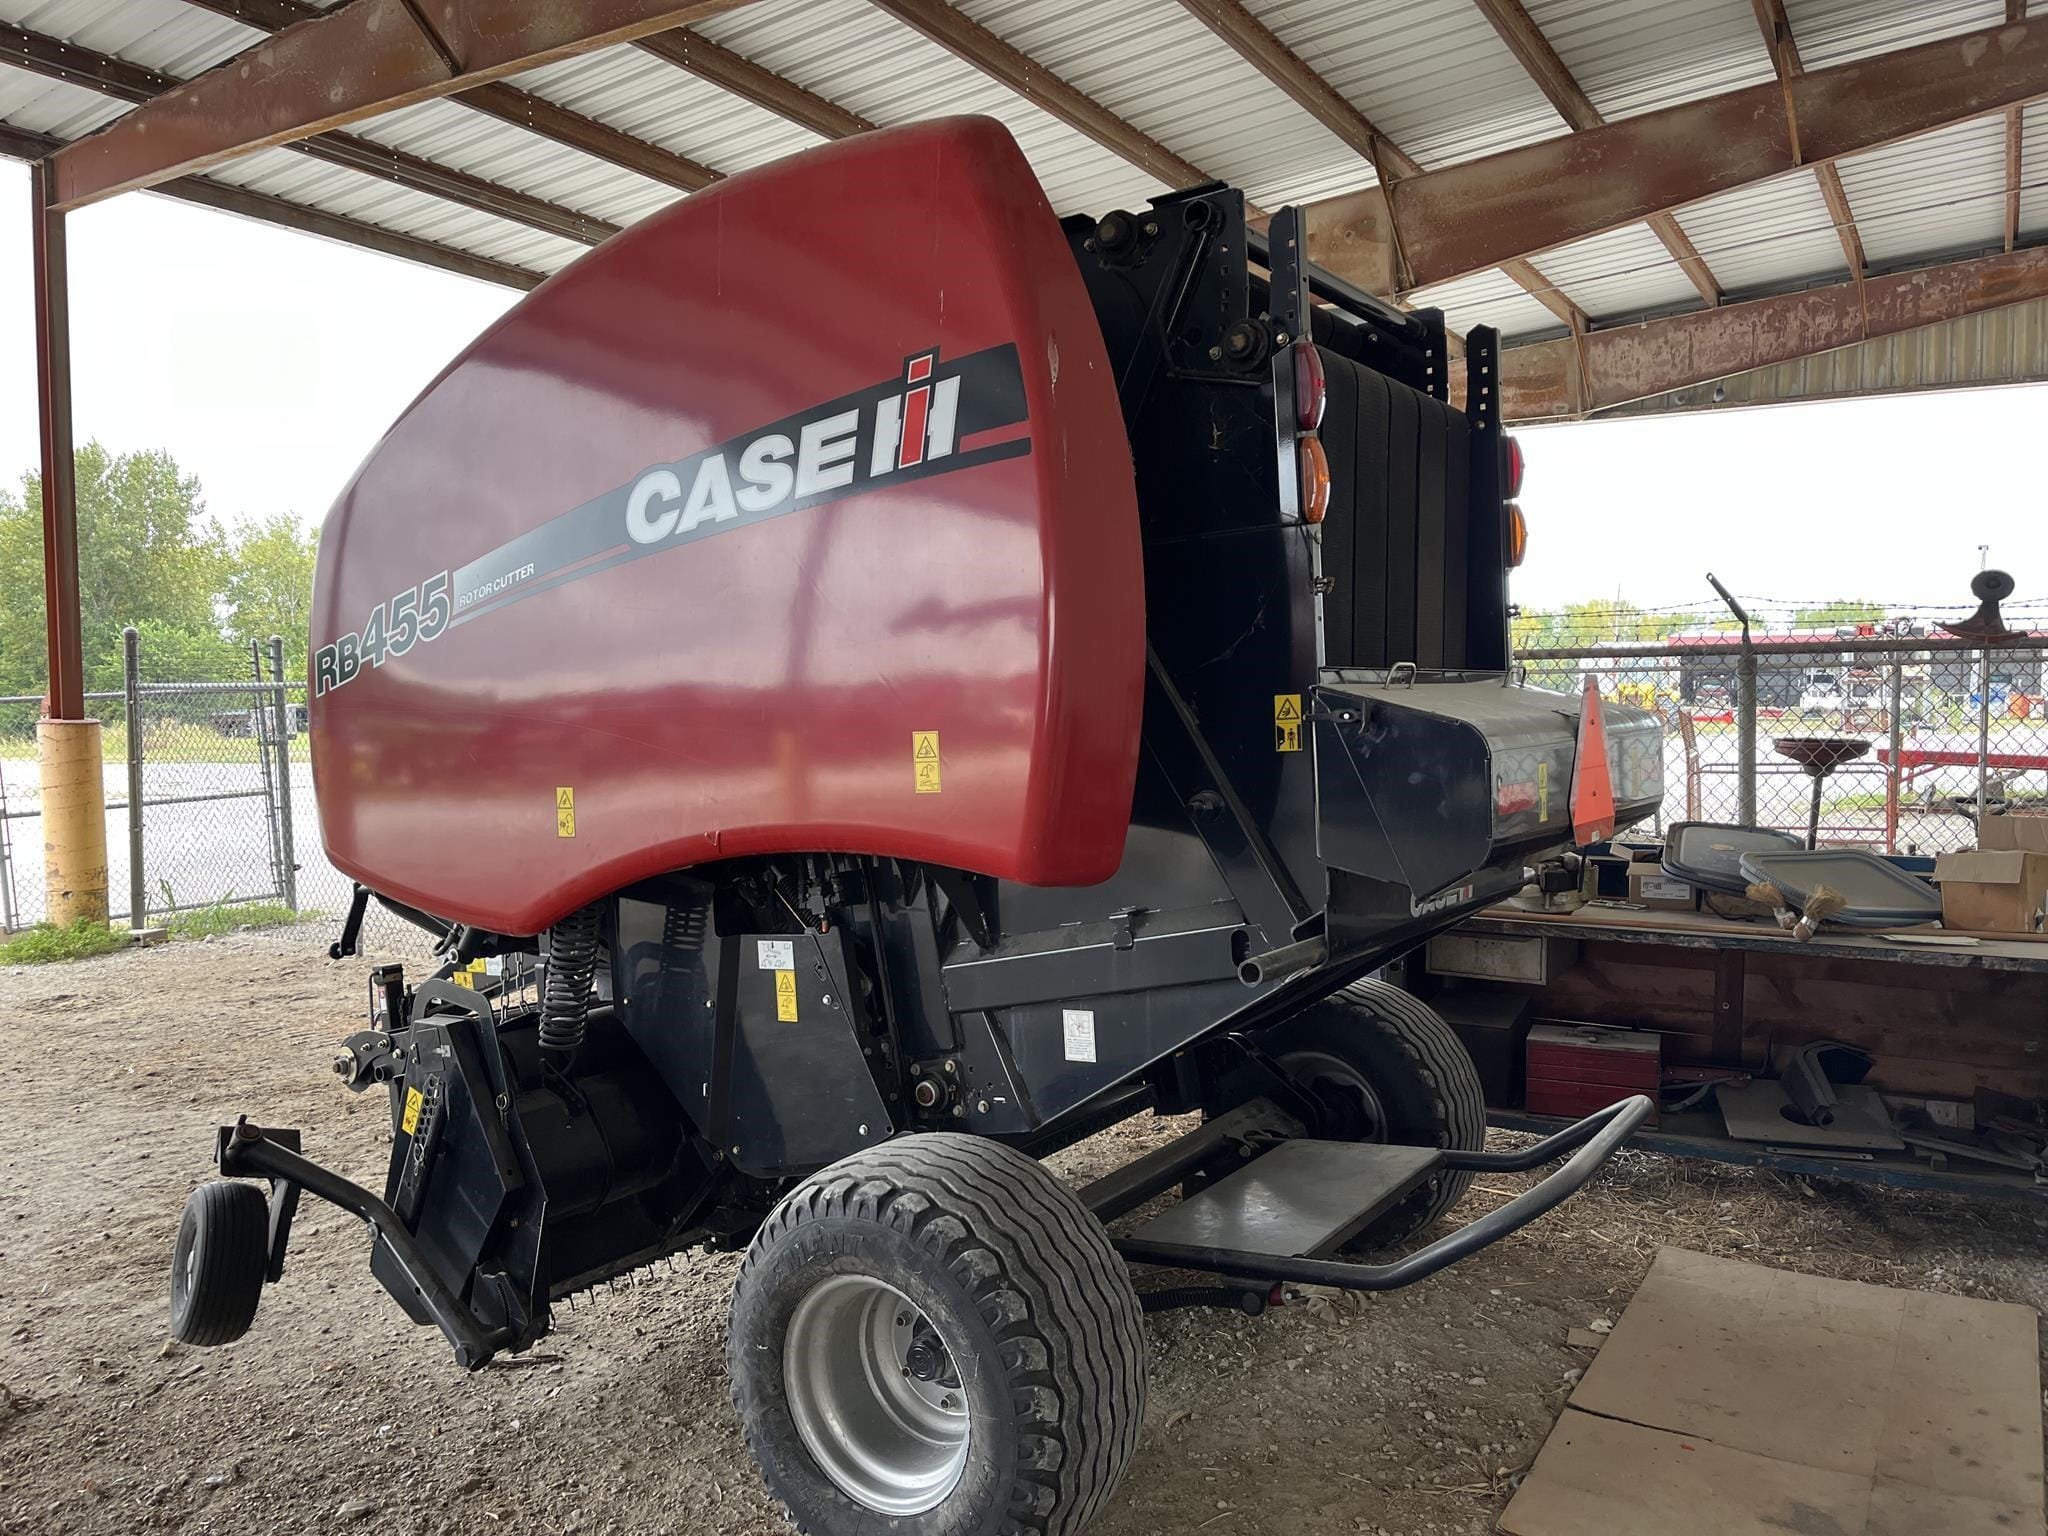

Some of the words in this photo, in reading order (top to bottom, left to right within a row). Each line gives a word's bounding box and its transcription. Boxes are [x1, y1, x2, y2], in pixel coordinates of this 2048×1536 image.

[626, 408, 860, 544] CASE
[315, 569, 450, 698] RB455
[458, 581, 493, 607] ROTOR
[493, 563, 535, 592] CUTTER
